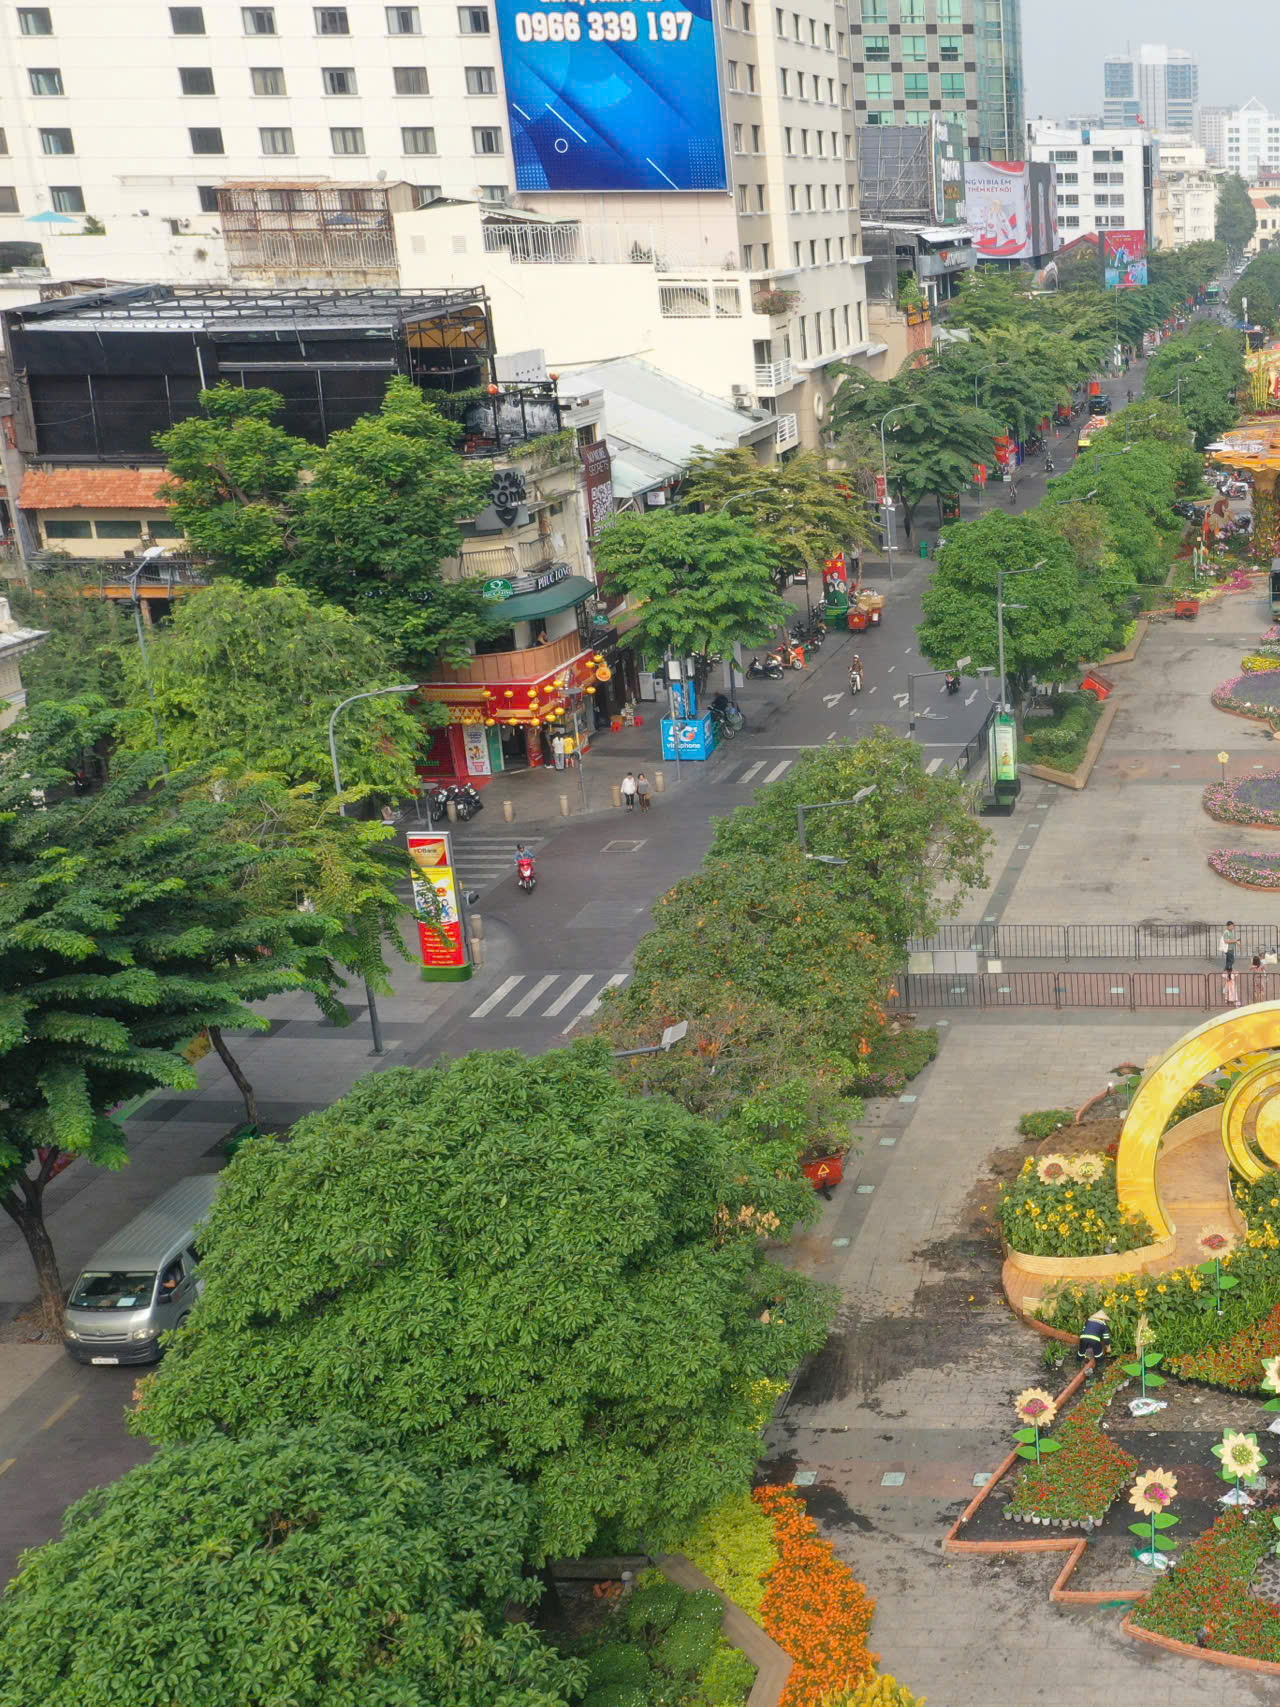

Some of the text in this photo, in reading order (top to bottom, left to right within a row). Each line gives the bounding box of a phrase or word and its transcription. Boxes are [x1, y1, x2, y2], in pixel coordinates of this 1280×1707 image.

[515, 11, 693, 42] 0966 339 197
